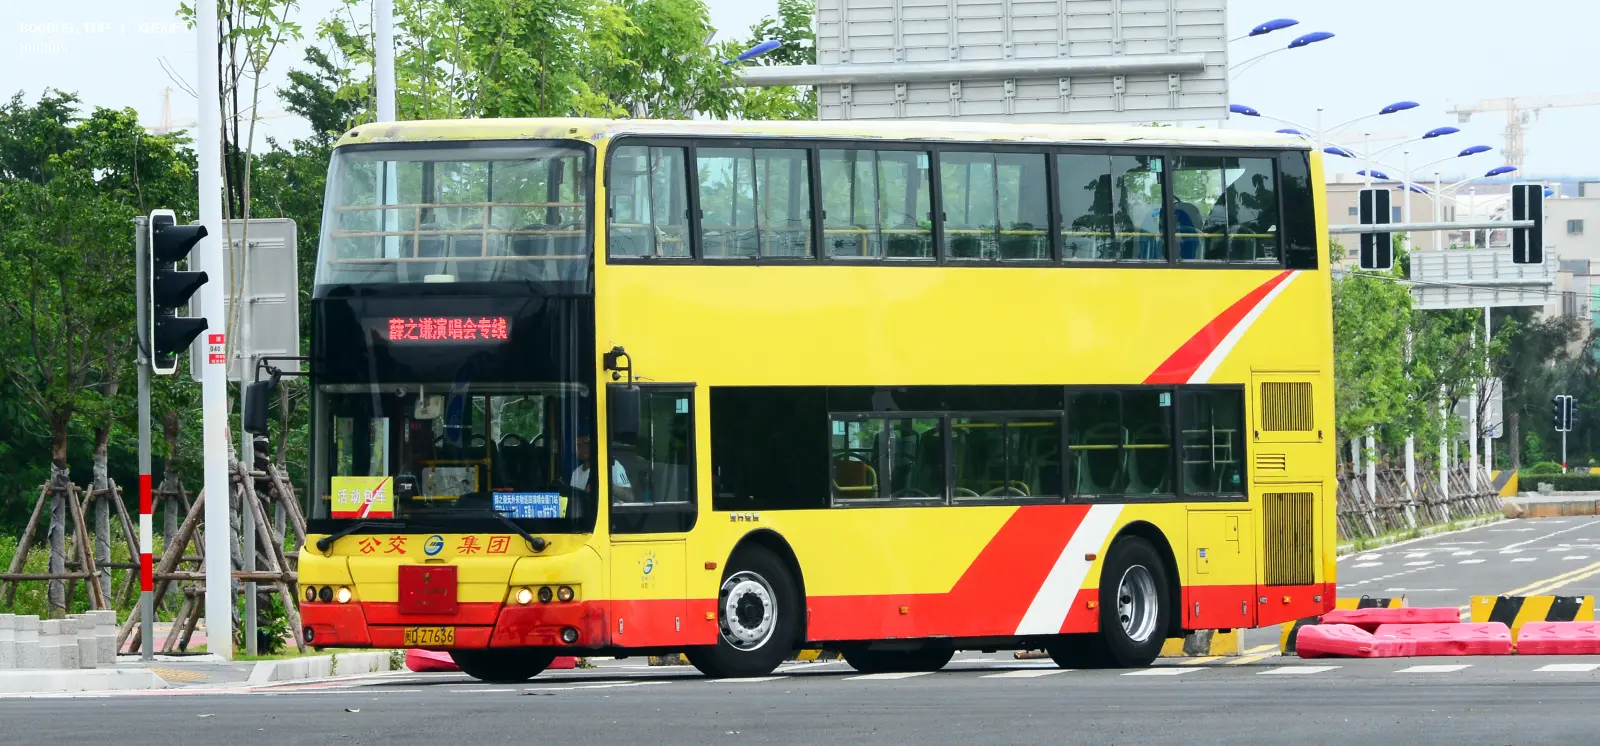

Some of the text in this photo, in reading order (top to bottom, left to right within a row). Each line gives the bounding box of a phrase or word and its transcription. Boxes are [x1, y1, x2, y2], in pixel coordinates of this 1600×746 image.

[389, 317, 508, 340] 薛之谦演唱会专线
[338, 488, 387, 504] 活动包车
[358, 535, 512, 554] 公交 集团
